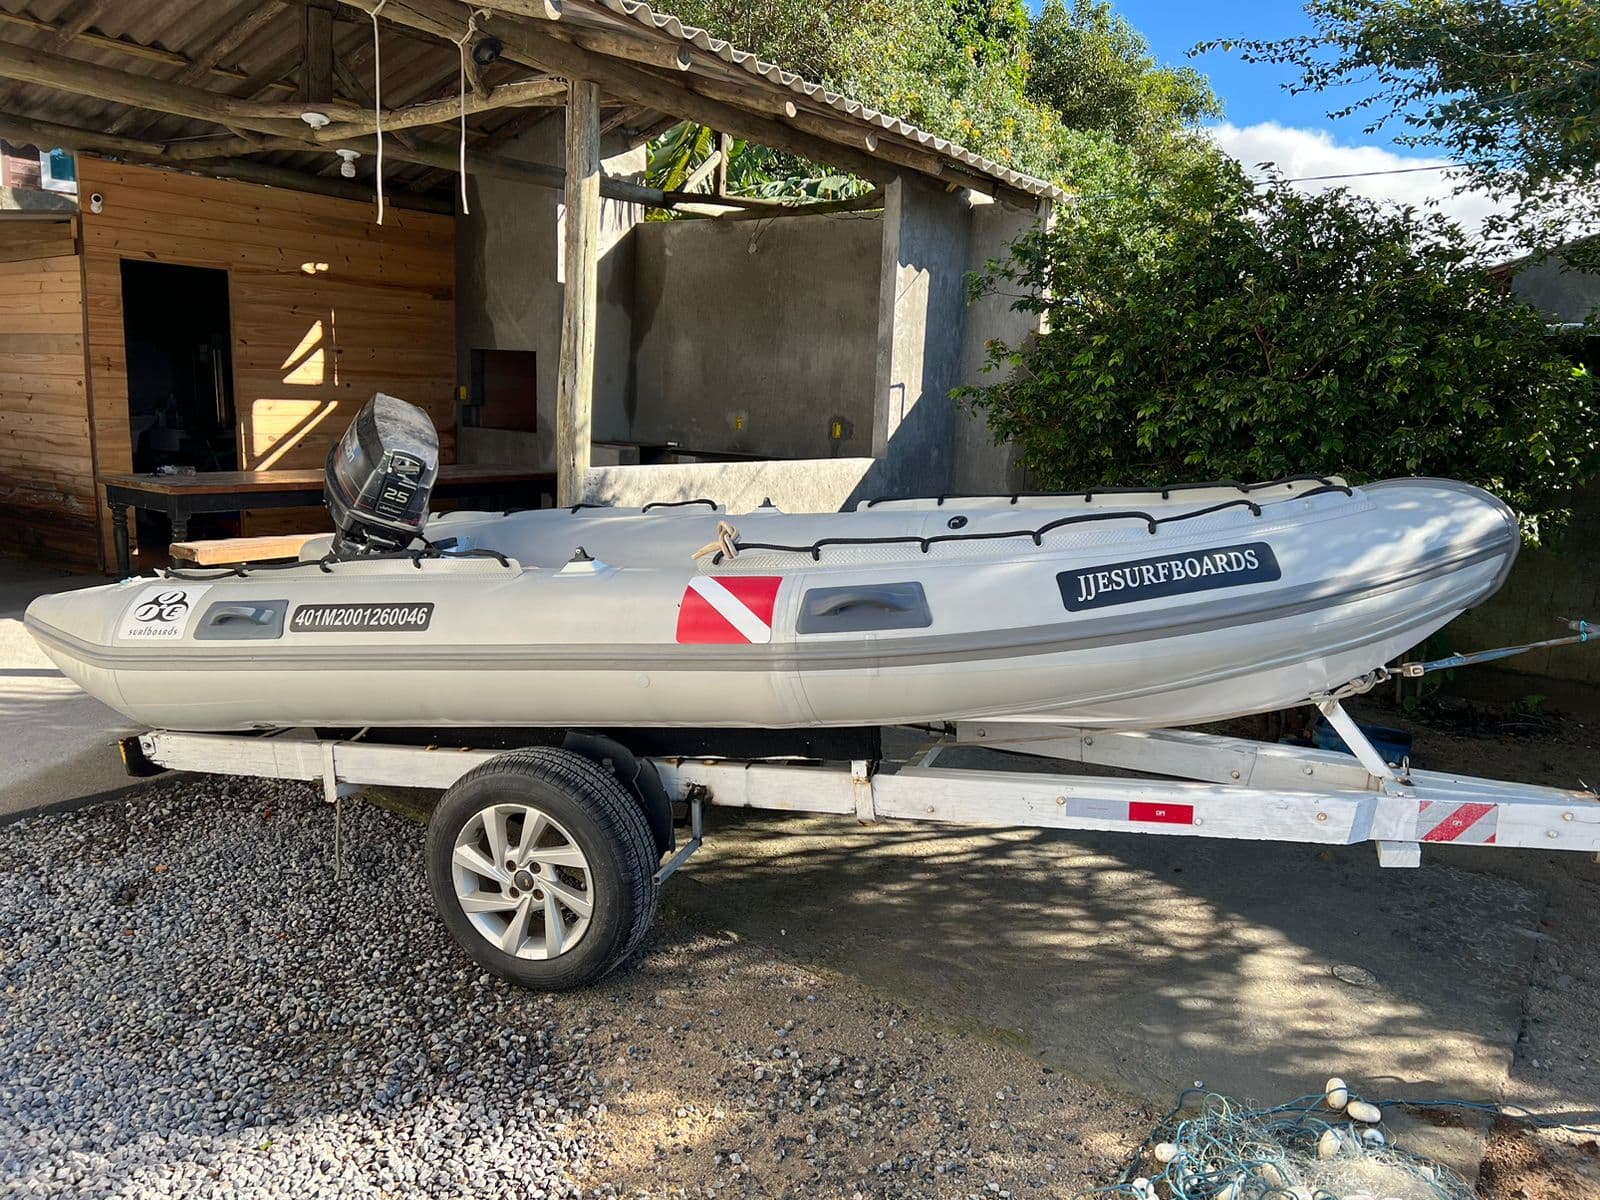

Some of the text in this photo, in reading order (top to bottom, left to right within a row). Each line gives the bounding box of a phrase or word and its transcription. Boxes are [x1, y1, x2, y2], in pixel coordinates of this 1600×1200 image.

[384, 487, 410, 503] 25
[1077, 549, 1259, 602] JJESURFBOARDS
[295, 607, 428, 626] 401M2001260046
